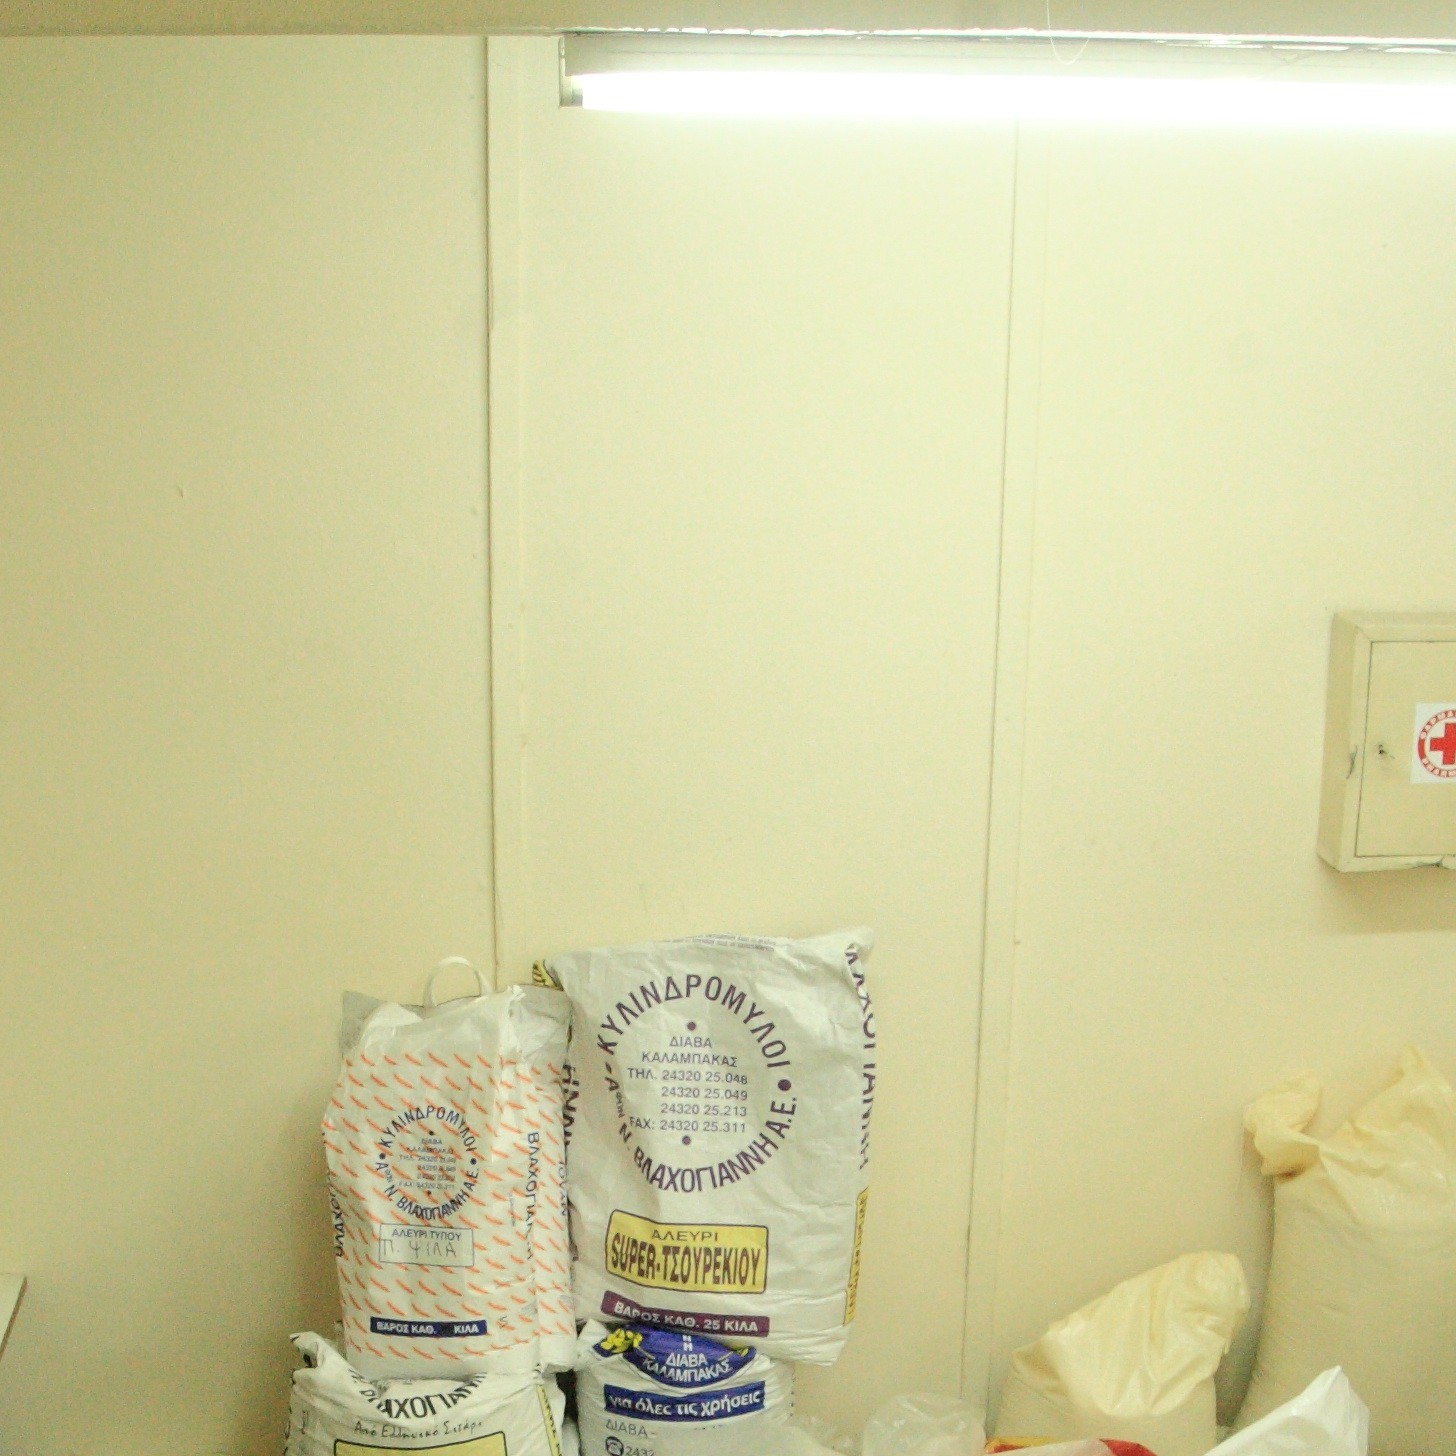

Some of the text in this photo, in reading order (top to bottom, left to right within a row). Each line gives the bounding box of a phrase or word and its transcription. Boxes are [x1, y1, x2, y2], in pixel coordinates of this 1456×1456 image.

[597, 973, 791, 1068] ΚΥΛΙΝΔΡΟΜΥΛΟΙ
[669, 1035, 713, 1049] ΔΙΑΒΑ
[641, 1051, 738, 1068] ΚΑΛΑΜΠΑΚΑΣ
[627, 1067, 748, 1085] ΤΗΛ. 24320 25.048
[660, 1086, 748, 1101] 24320 25.049
[660, 1102, 748, 1117] 24320 25.213
[378, 1104, 478, 1152] ΚΥΛΙΝΔΡΟΜΥΛΟΙ
[629, 1116, 746, 1133] FAX: 24320 25.311
[634, 1132, 779, 1194] ΒΛΑΧΟΓΙΑΝΝΗ
[396, 1188, 470, 1222] ΒΛΑΧΟΓΙΑΝΝΗ
[391, 1228, 462, 1242] ΑΛΕΥΡΙ ΤΥΠΟΥ
[651, 1229, 719, 1242] ΑΛΕΥΡΙ
[610, 1231, 762, 1287] SUPER-ΤΣΟΥΡΕΚΙΟΥ
[613, 1300, 759, 1333] ΒΑΡΟΣ ΚΑΘ. 25 ΚΙΛΑ
[376, 1321, 480, 1335] ΒΑΡΟΣ ΚΑΘ. ΚΙΛΑ
[665, 1351, 708, 1367] ΔΙΑΒΑ
[607, 1389, 762, 1418] για όλες τις χρήσεις
